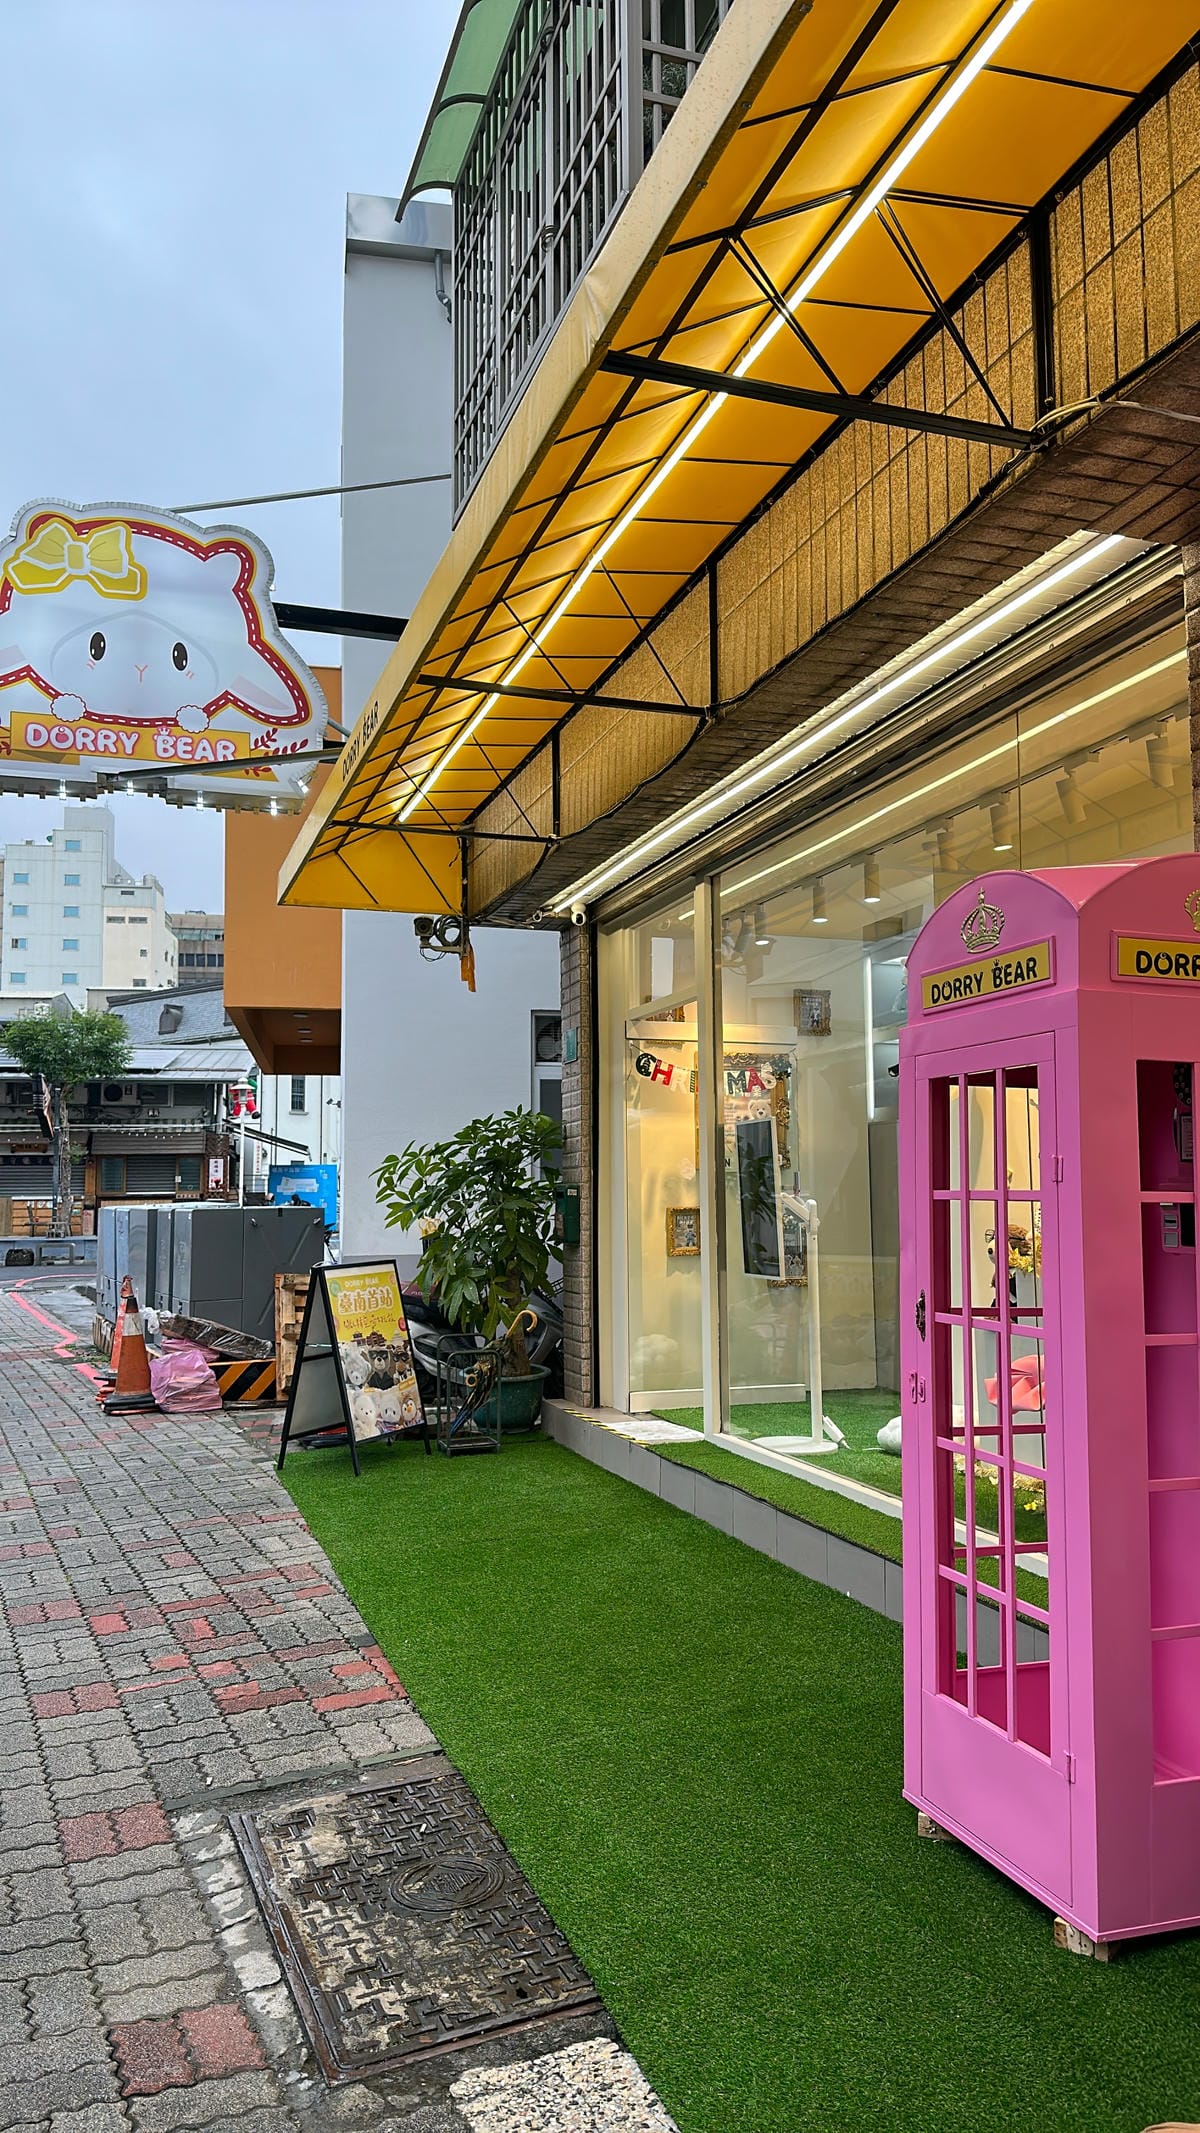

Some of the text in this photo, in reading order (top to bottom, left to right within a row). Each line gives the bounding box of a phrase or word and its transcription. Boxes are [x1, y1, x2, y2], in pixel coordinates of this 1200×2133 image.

[25, 722, 236, 762] DORRY BEAR
[931, 957, 1038, 1005] DORRY BEAR
